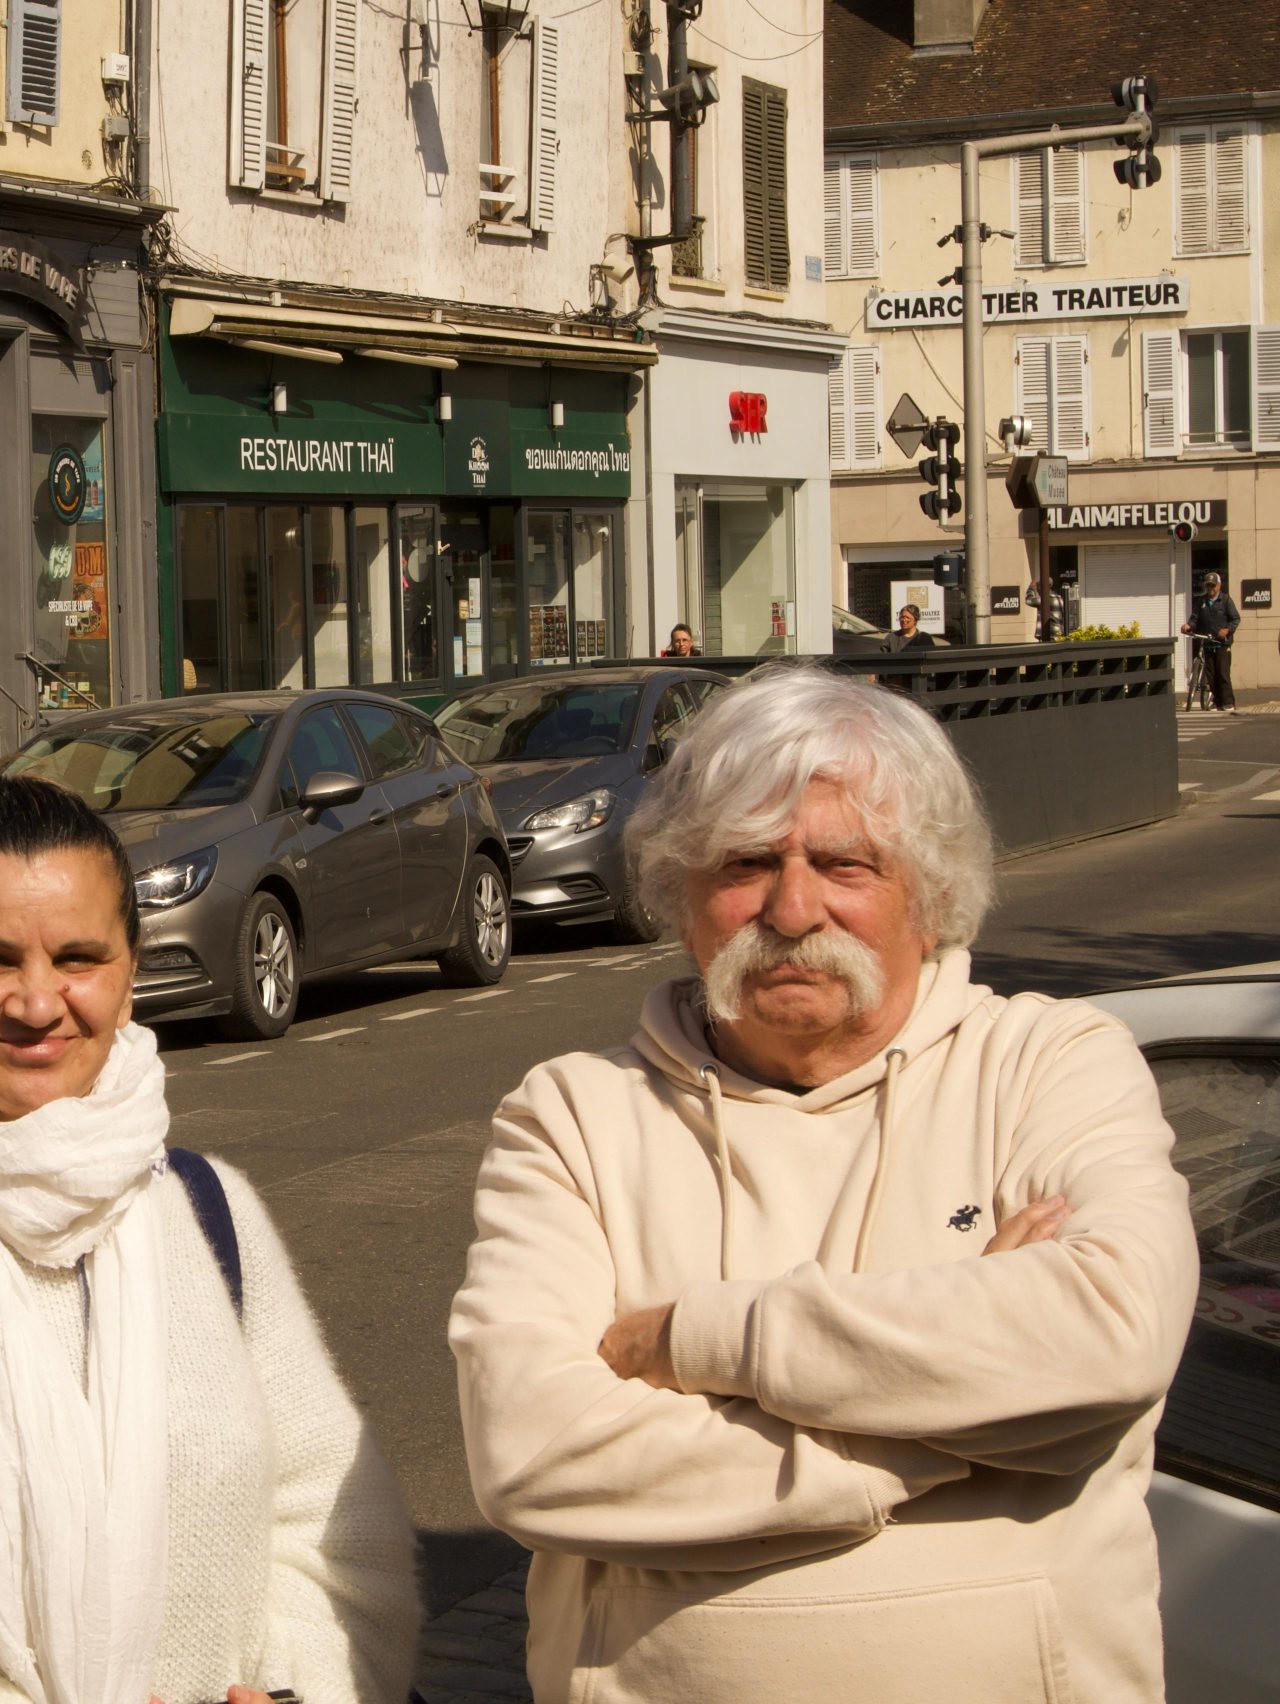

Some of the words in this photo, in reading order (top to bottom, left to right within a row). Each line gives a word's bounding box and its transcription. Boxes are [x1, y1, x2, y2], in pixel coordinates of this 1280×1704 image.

[20, 251, 42, 280] DE
[44, 263, 80, 309] VAPE
[876, 291, 1038, 321] CHARCTIER
[1052, 283, 1180, 312] TRAITEUR
[240, 438, 354, 472] RESTAURANT
[357, 437, 394, 473] THAÏ
